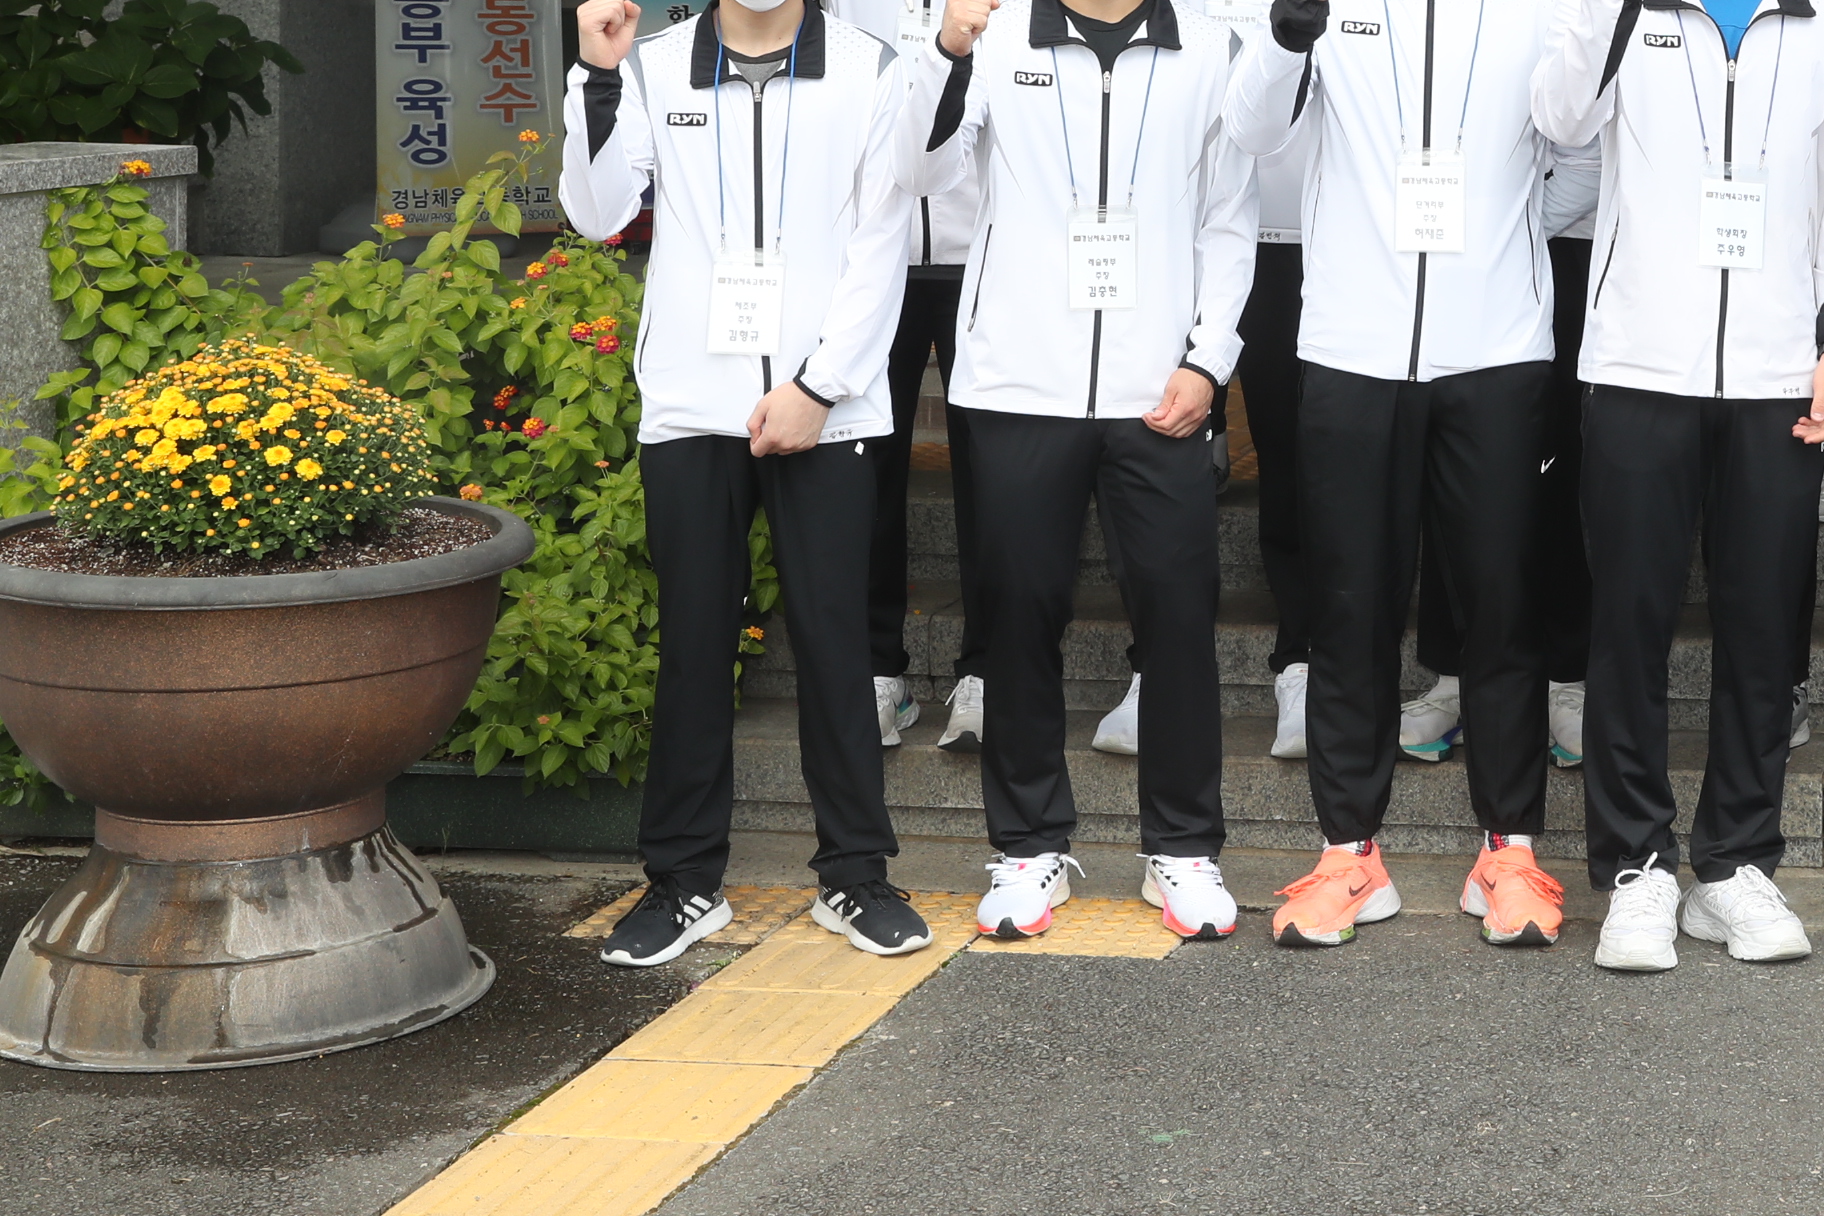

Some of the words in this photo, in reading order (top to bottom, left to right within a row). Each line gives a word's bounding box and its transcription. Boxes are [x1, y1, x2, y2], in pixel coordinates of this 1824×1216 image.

[1344, 22, 1379, 34] RYN
[1646, 35, 1679, 46] RYN
[1017, 73, 1051, 84] RYN
[395, 78, 451, 166] 육성
[669, 114, 707, 125] RYN
[1415, 228, 1444, 239] 허재준
[1717, 228, 1747, 239] 학생회장
[1718, 244, 1745, 257] 주우영
[1088, 258, 1116, 266] 레슬링부
[726, 277, 777, 286] 경남체육고등학교
[1096, 272, 1109, 280] 주장
[736, 302, 757, 310] 체조부
[738, 316, 752, 324] 주장
[729, 330, 759, 342] 김형규
